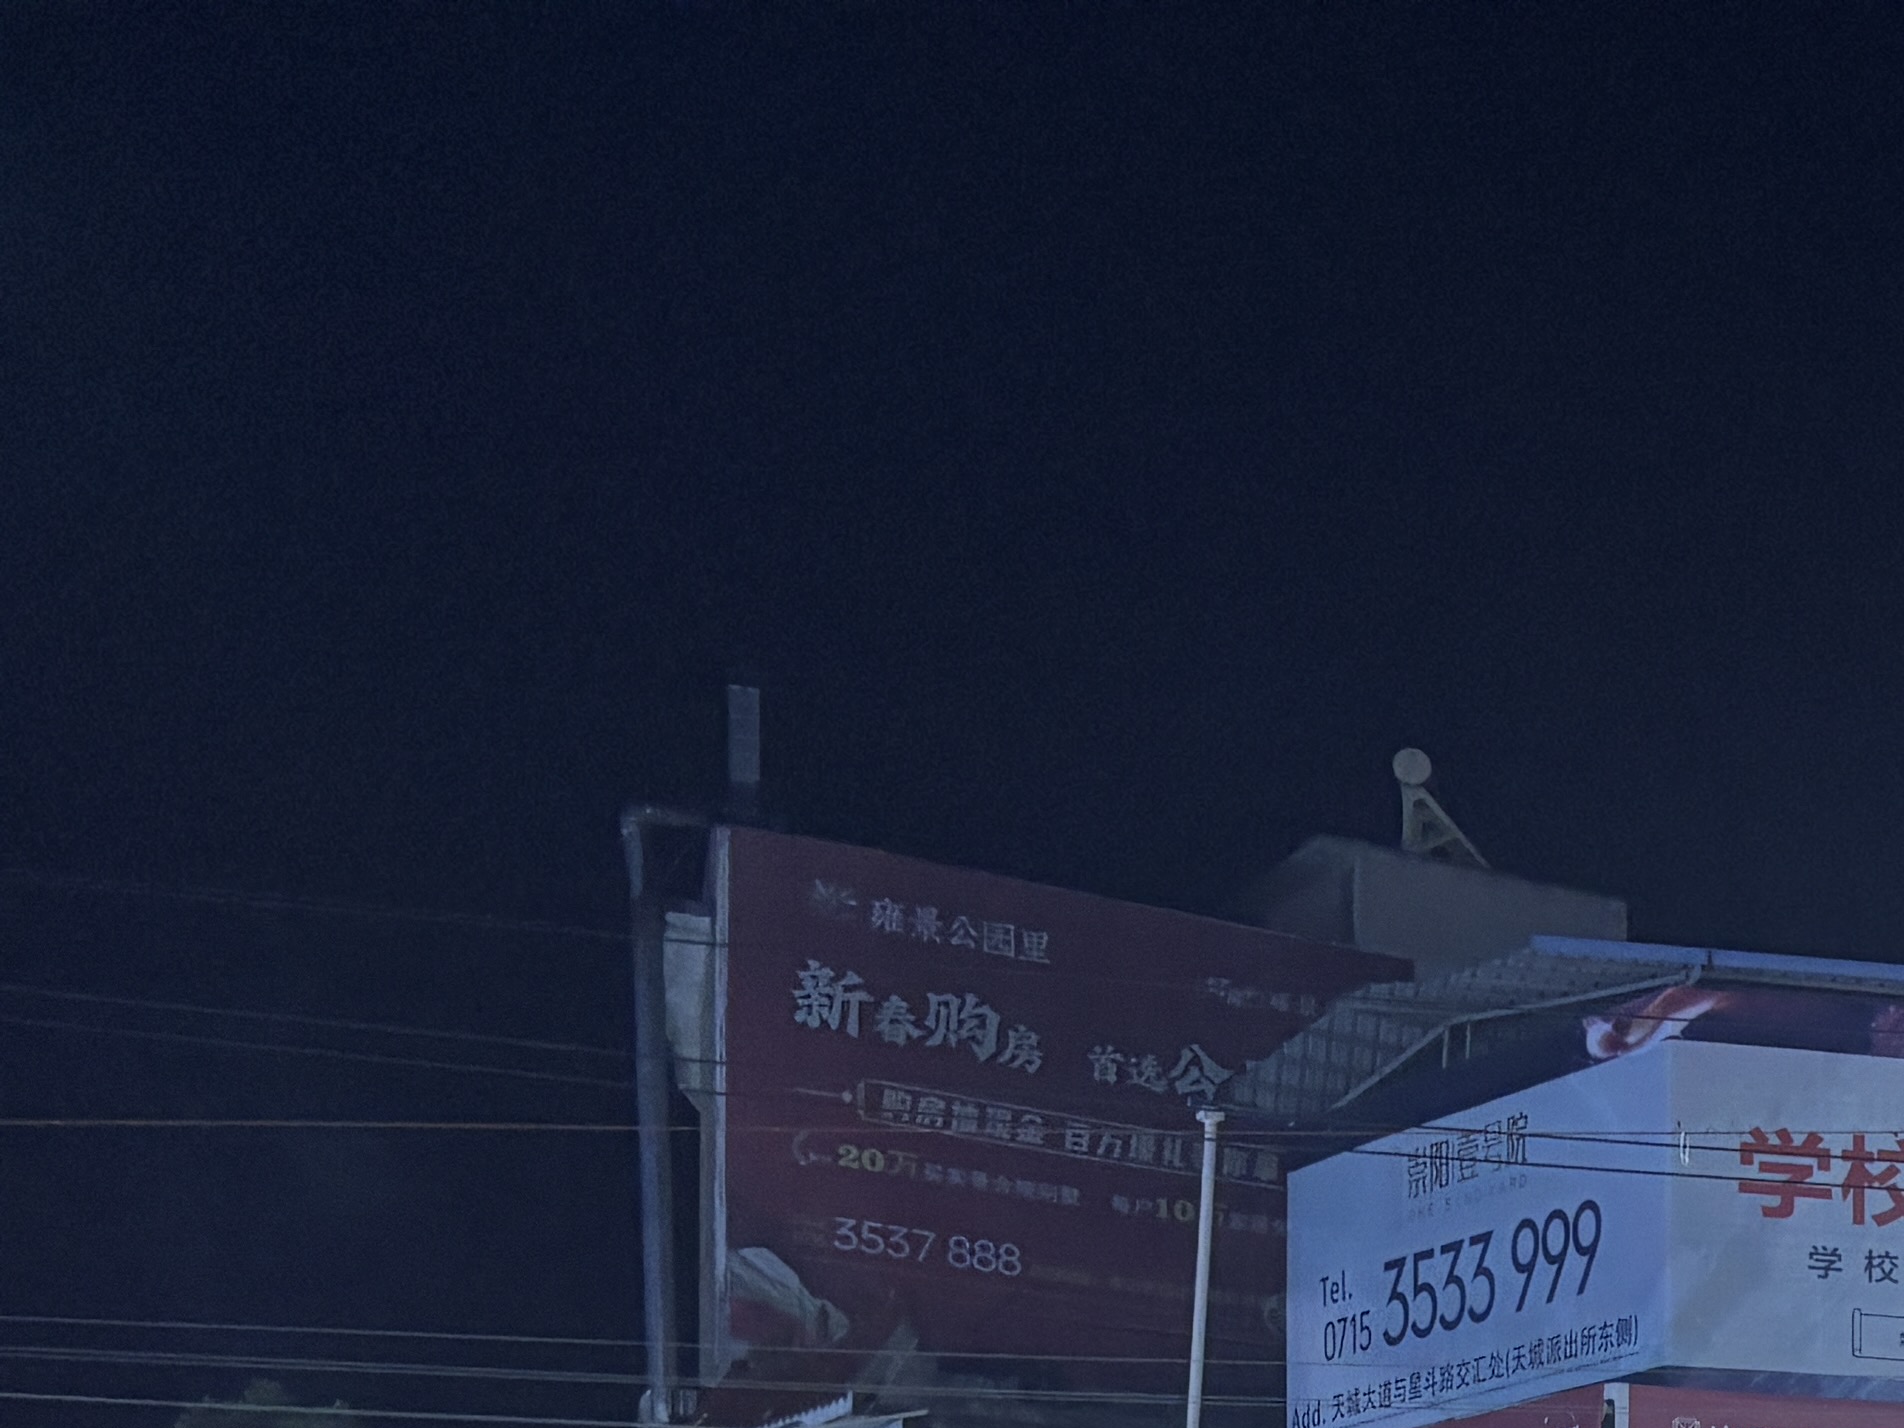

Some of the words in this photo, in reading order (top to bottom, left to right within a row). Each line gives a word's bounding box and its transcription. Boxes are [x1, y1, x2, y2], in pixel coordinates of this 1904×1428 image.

[792, 959, 1044, 1075] 新春购房
[832, 1216, 937, 1263] 3537
[947, 1235, 1023, 1278] 888
[1319, 1270, 1353, 1305] Tel.
[1323, 1309, 1372, 1362] 0715
[1382, 1230, 1496, 1347] 3533
[1511, 1199, 1603, 1313] 999
